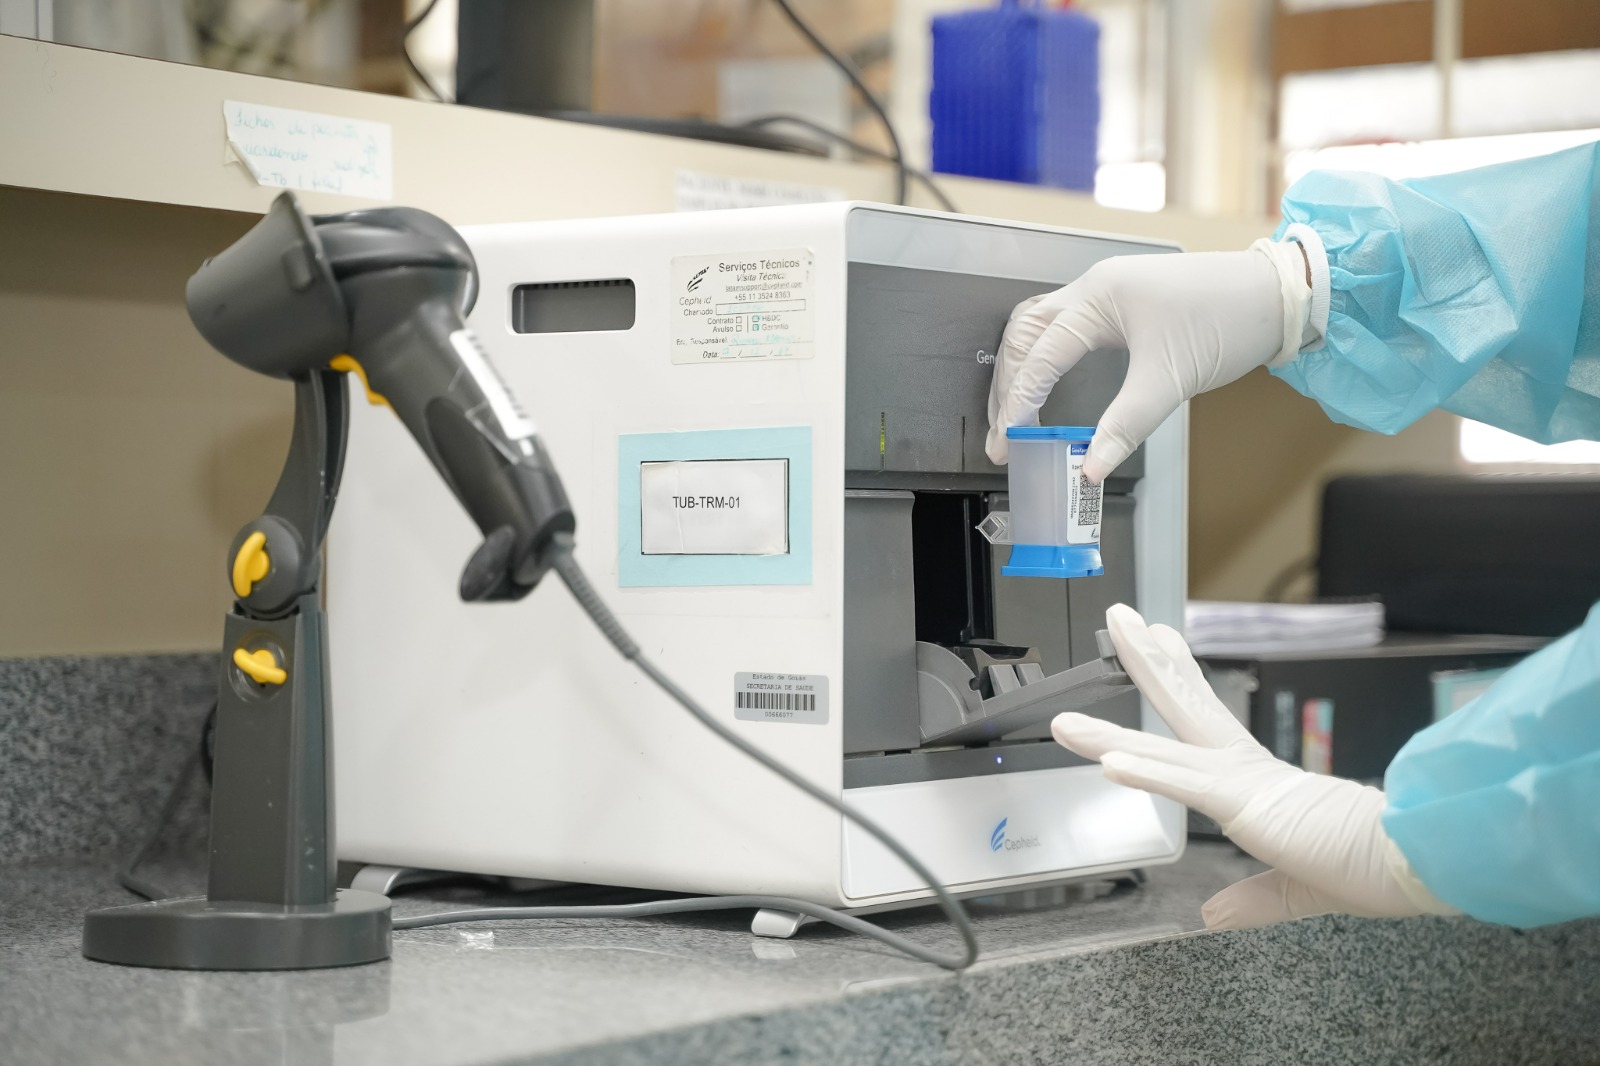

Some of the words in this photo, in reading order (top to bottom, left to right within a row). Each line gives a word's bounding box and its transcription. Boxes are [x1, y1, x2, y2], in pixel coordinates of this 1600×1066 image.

[718, 262, 757, 273] Serviços
[760, 259, 800, 270] Técnicos
[758, 292, 773, 300] 3524
[775, 291, 791, 299] 8363
[707, 316, 735, 325] Contrato
[712, 325, 734, 333] Avulso
[976, 349, 996, 365] Gen
[672, 496, 740, 509] TUB-TRM-01
